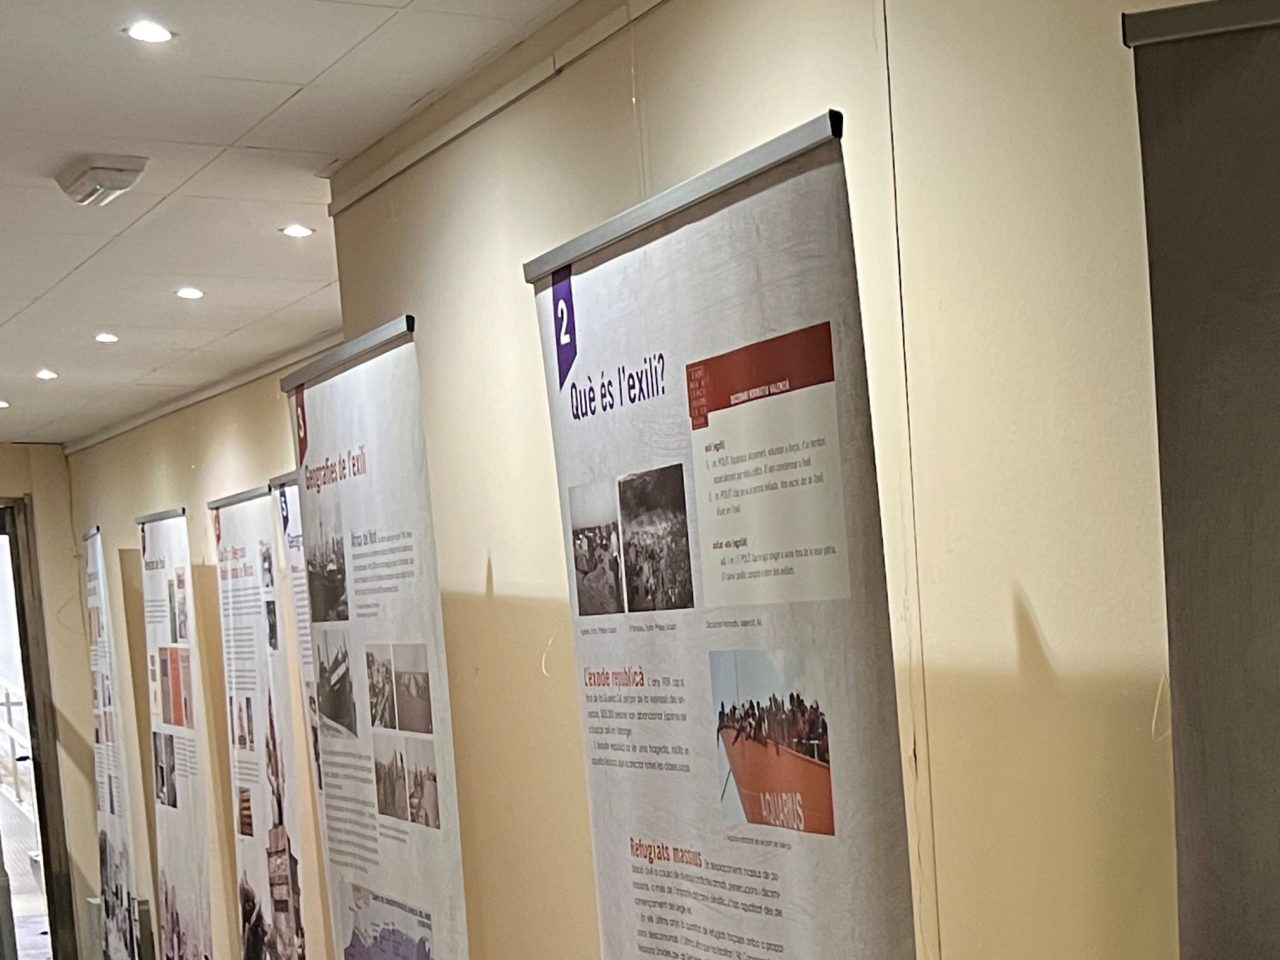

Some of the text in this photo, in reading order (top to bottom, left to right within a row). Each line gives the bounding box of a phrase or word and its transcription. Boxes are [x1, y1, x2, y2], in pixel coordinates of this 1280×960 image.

[558, 298, 571, 345] 2
[570, 375, 596, 421] Què
[600, 371, 615, 412] és
[617, 352, 665, 407] l'exili?
[629, 836, 671, 865] Refugiats
